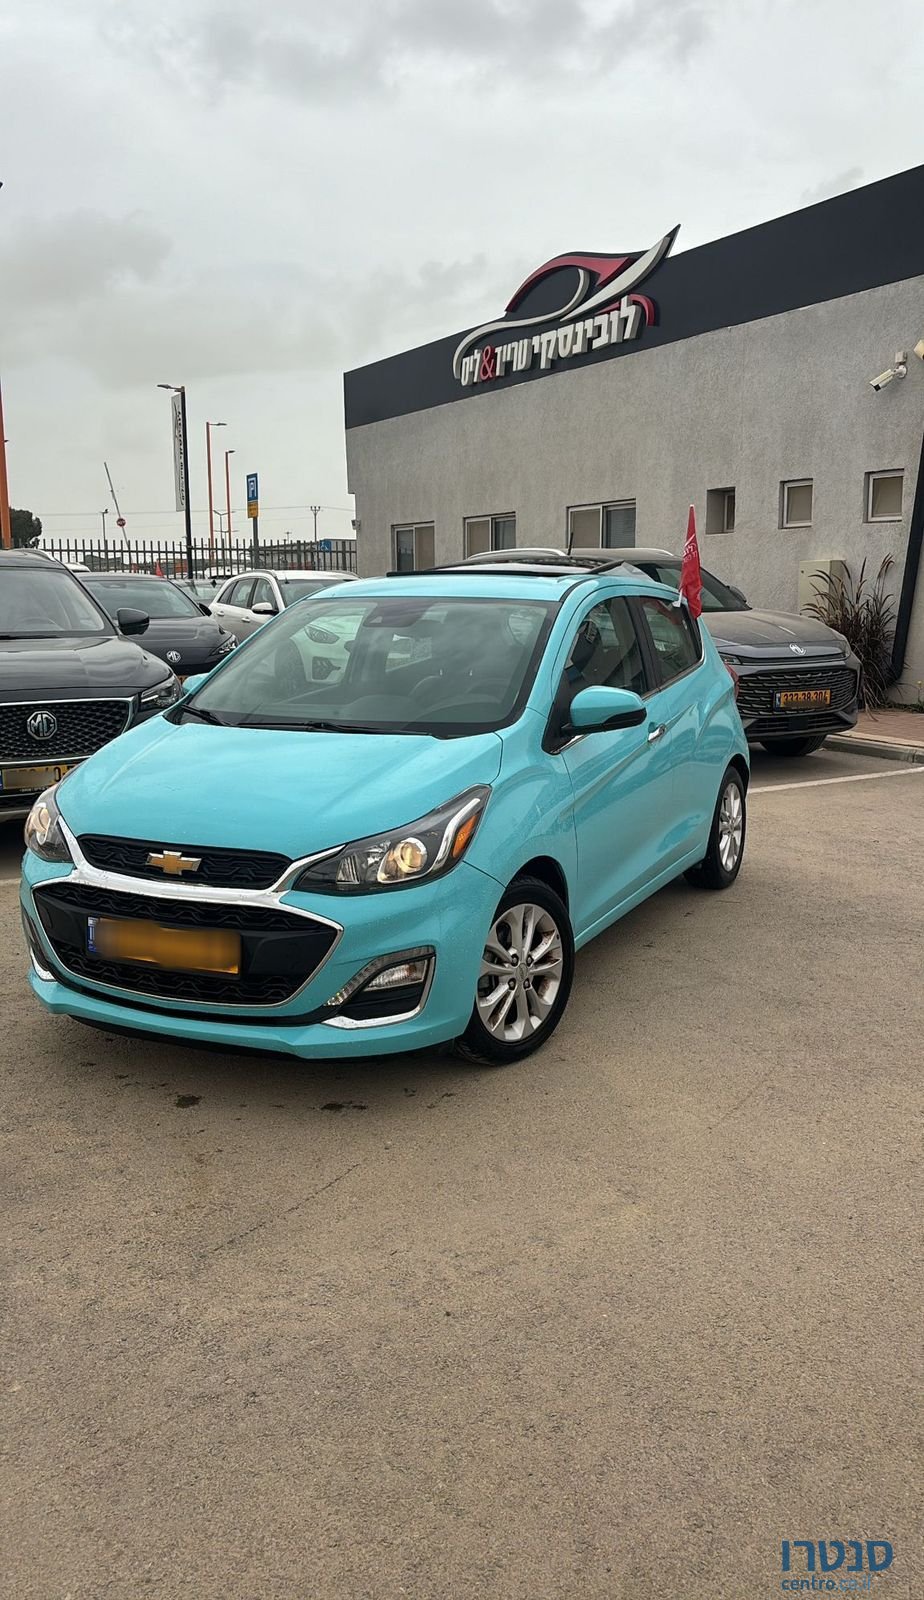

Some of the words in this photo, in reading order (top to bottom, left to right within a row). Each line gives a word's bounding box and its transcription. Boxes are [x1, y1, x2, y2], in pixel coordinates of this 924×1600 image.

[532, 295, 641, 369] לובינסקי
[167, 650, 181, 662] MG
[29, 712, 55, 738] MG
